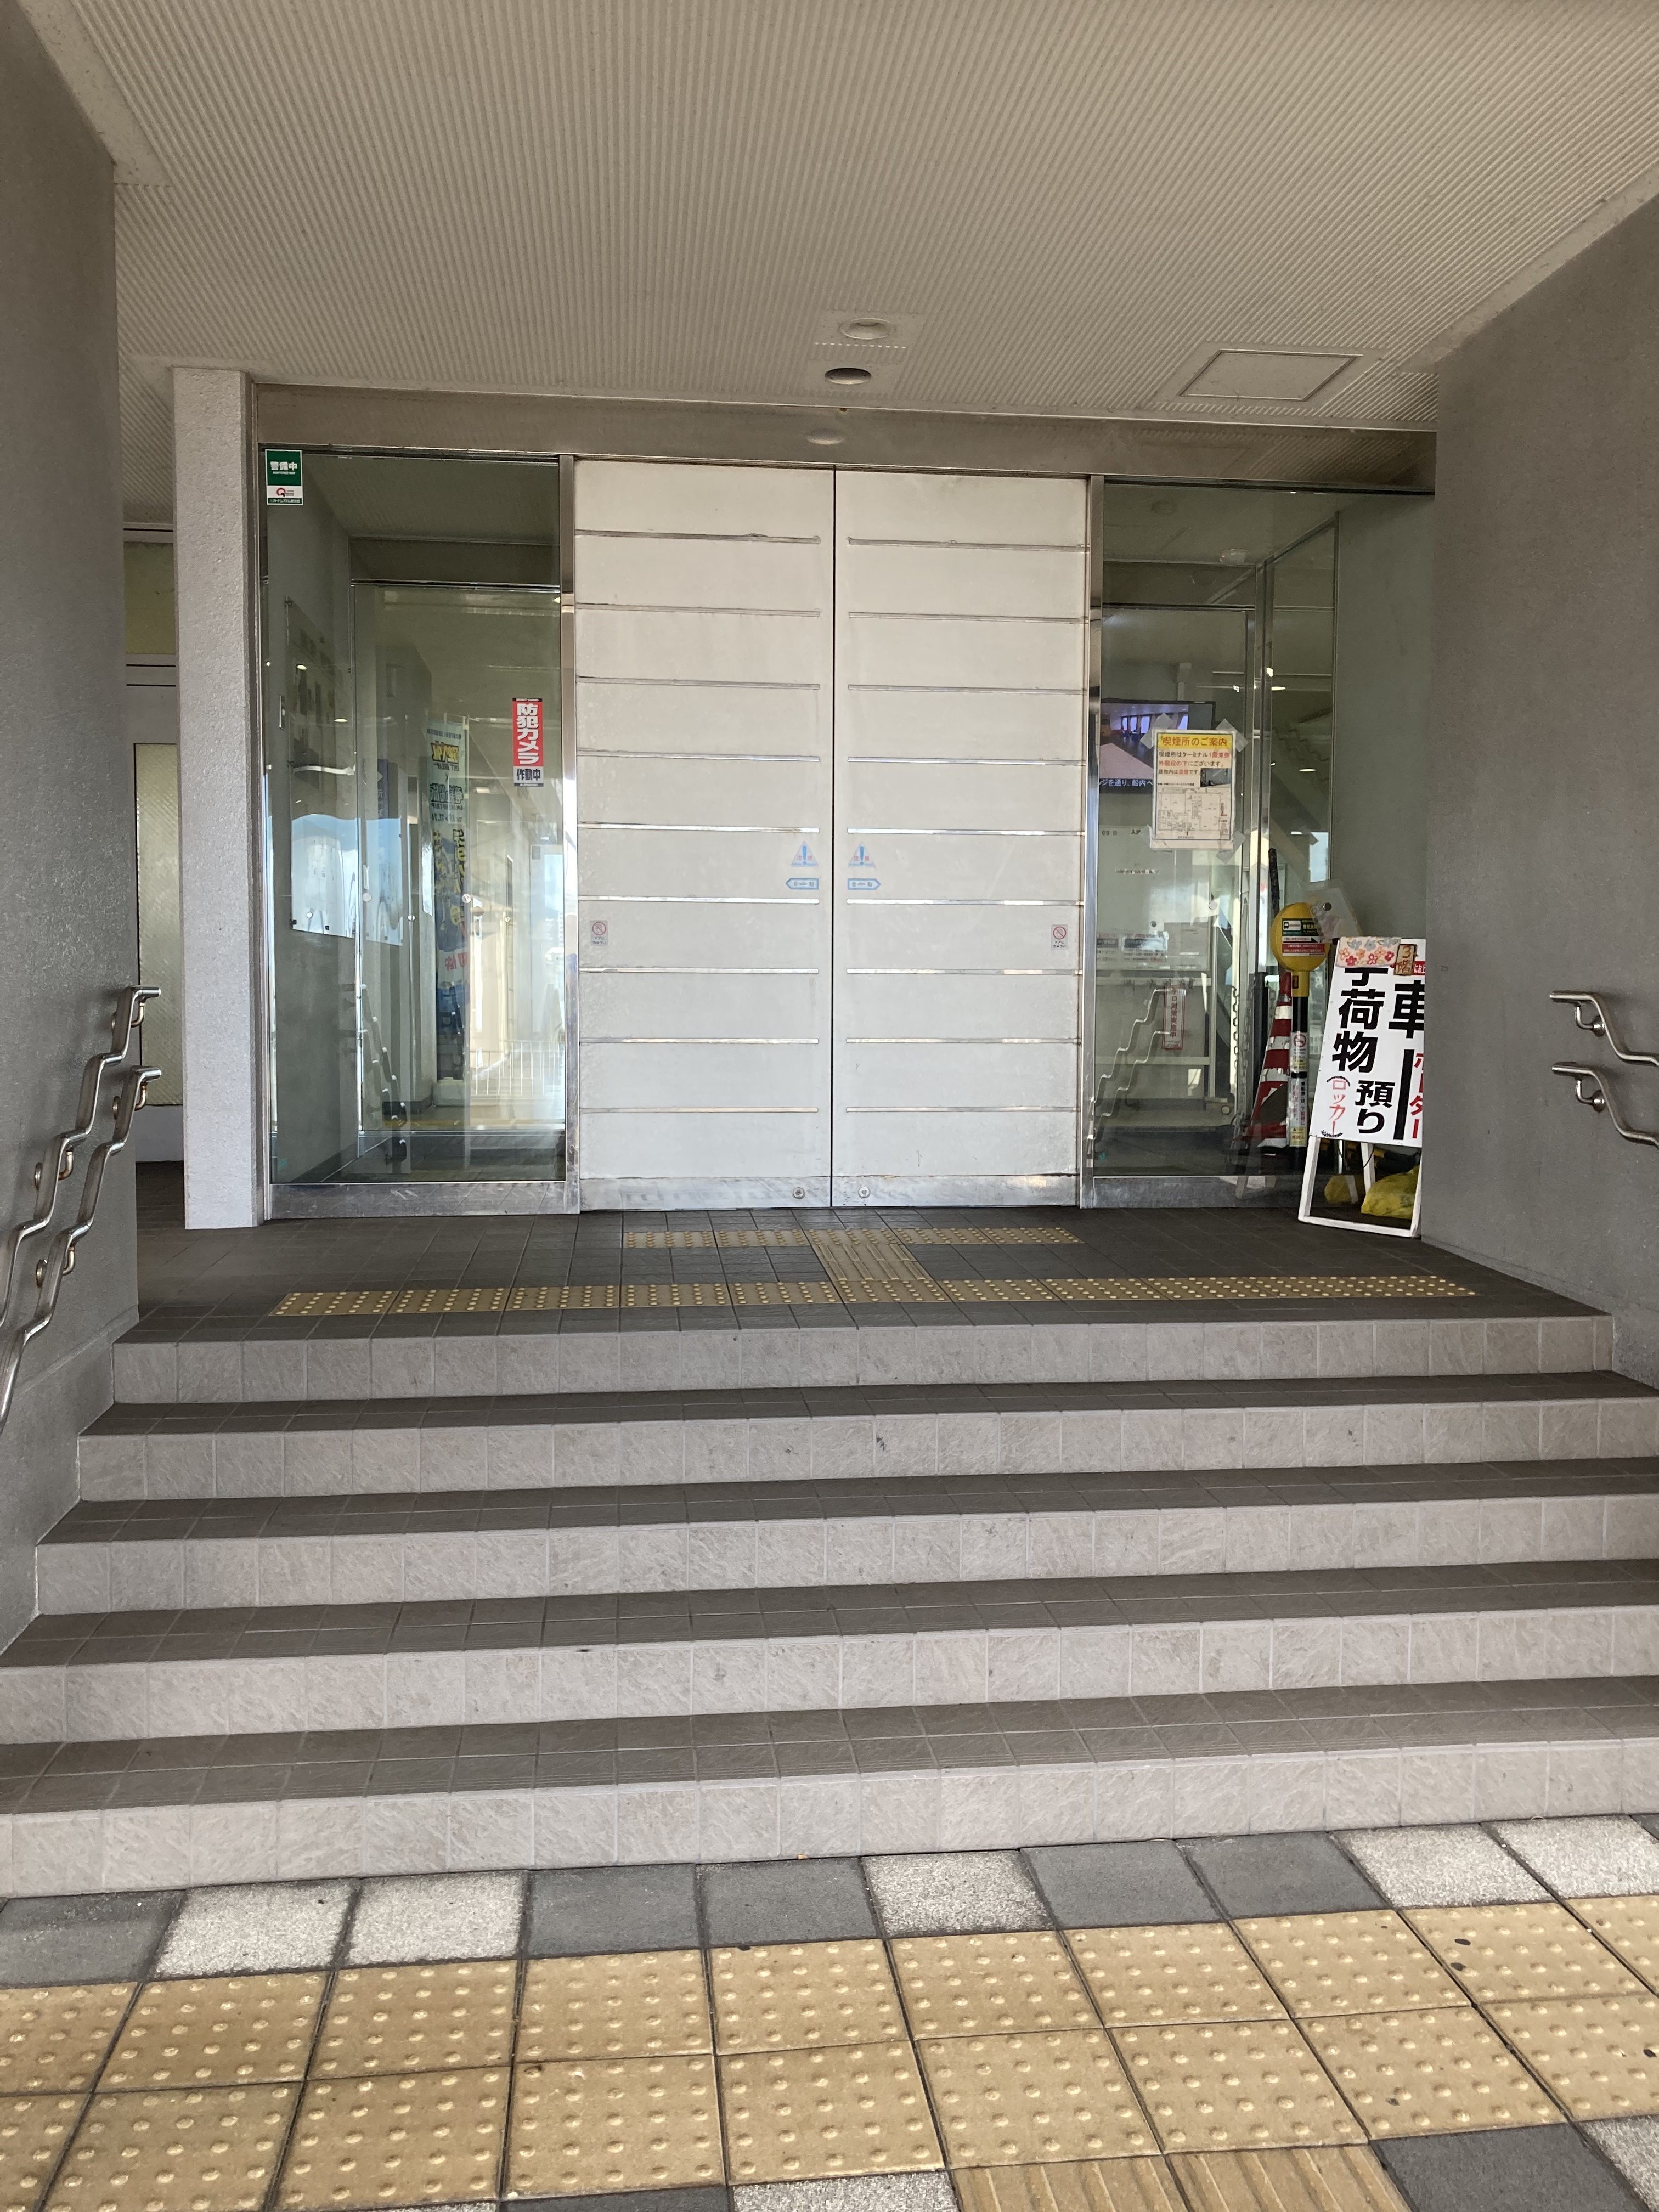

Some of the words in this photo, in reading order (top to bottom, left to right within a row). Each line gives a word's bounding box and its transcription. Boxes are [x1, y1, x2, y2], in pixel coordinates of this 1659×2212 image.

[270, 461, 298, 471] 警備中
[516, 703, 539, 765] 防犯カメラ
[1162, 737, 1227, 747] 喫煙所のご案内
[517, 769, 540, 781] 作動中
[1355, 1080, 1395, 1134] 預り
